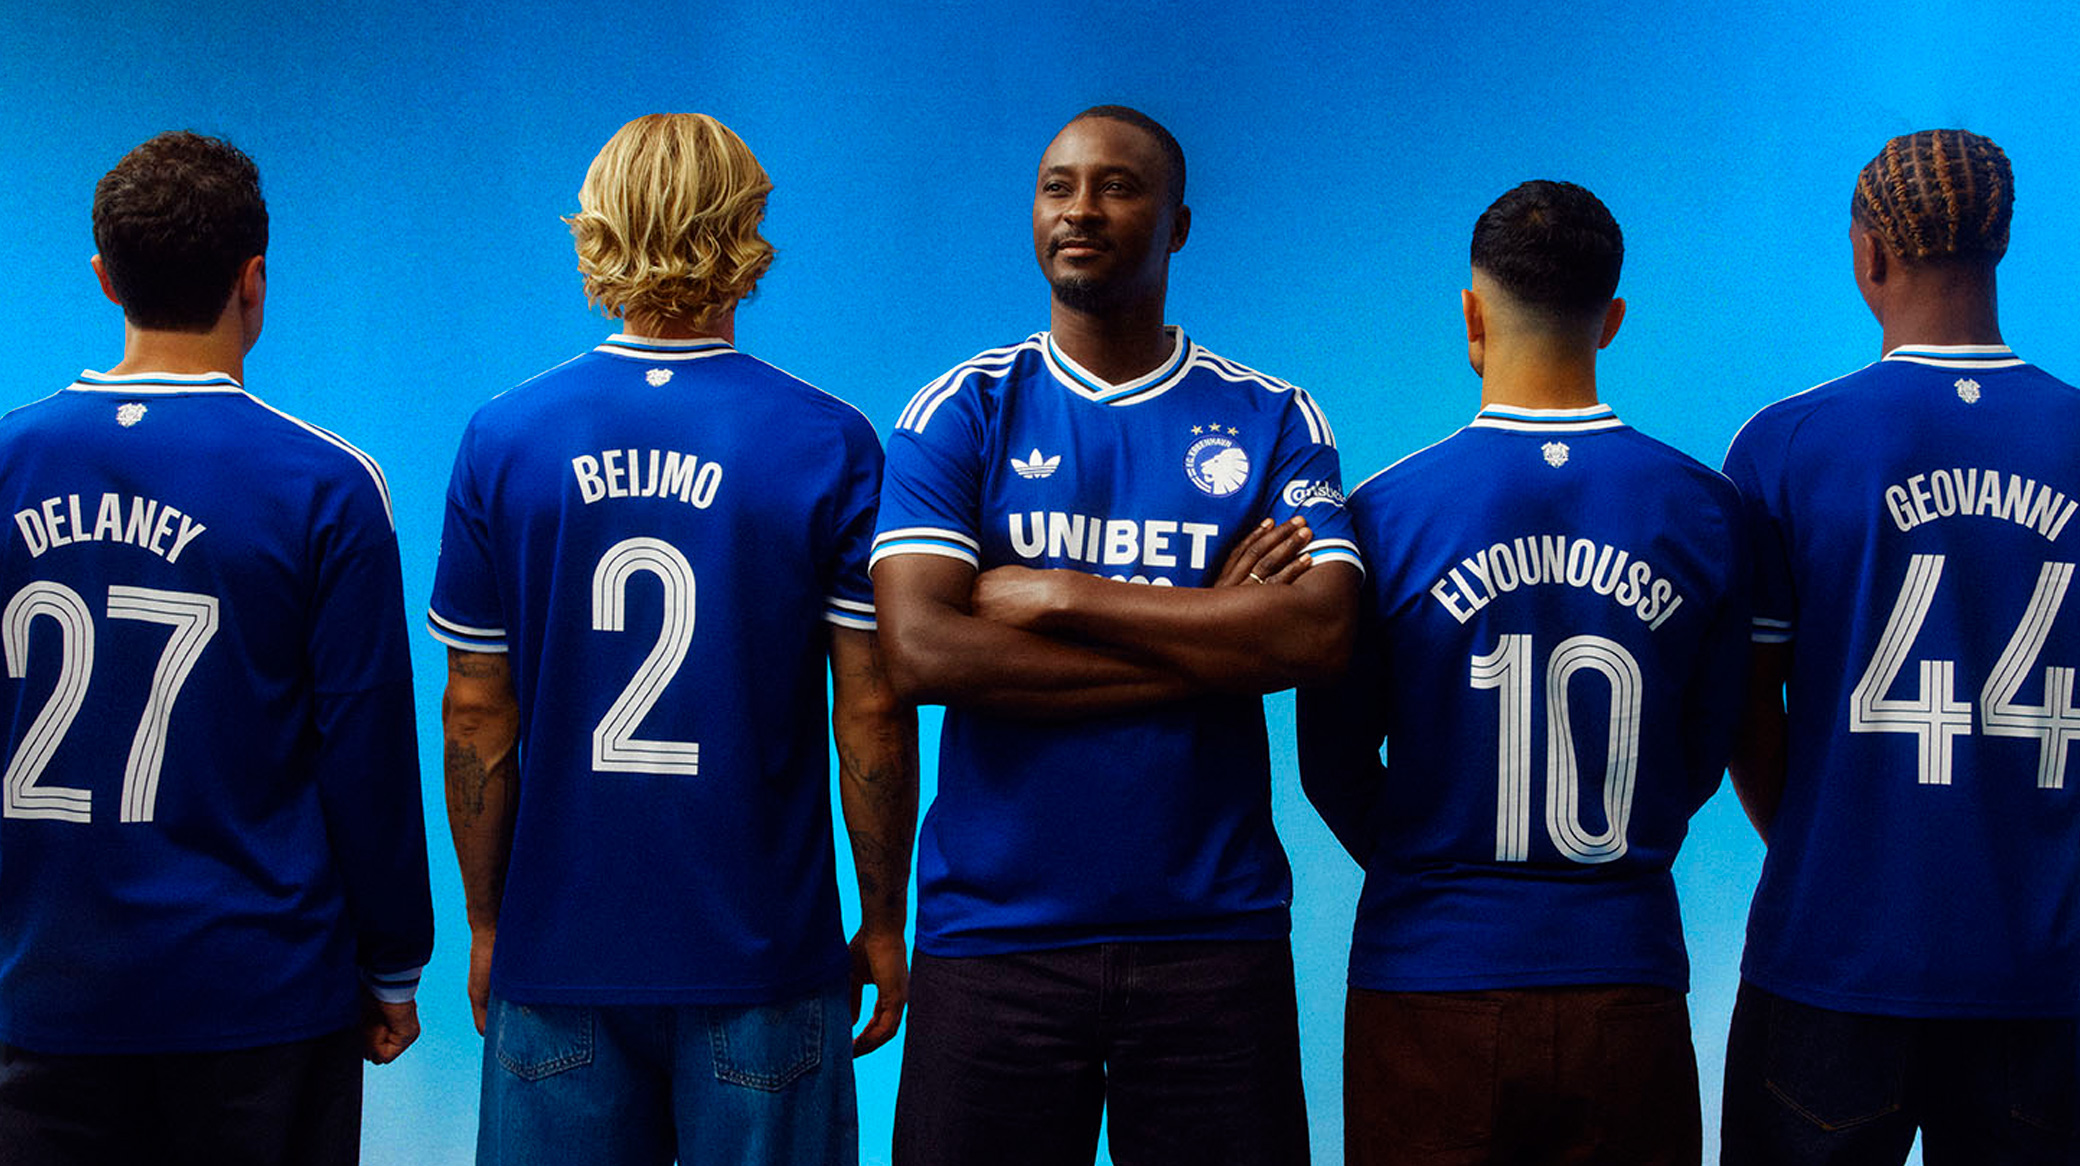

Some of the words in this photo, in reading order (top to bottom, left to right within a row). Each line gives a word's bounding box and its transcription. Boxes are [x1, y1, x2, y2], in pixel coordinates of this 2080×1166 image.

[572, 448, 723, 509] BEIJMO
[1885, 467, 2079, 541] GEOVANNI
[14, 493, 206, 564] DELANEY
[1008, 511, 1219, 569] UNIBET
[1430, 535, 1683, 631] ELYOUNOUSSI
[2, 580, 219, 823] 27
[592, 537, 699, 775] 2
[1849, 554, 2080, 789] 44
[1470, 634, 1642, 864] 10
